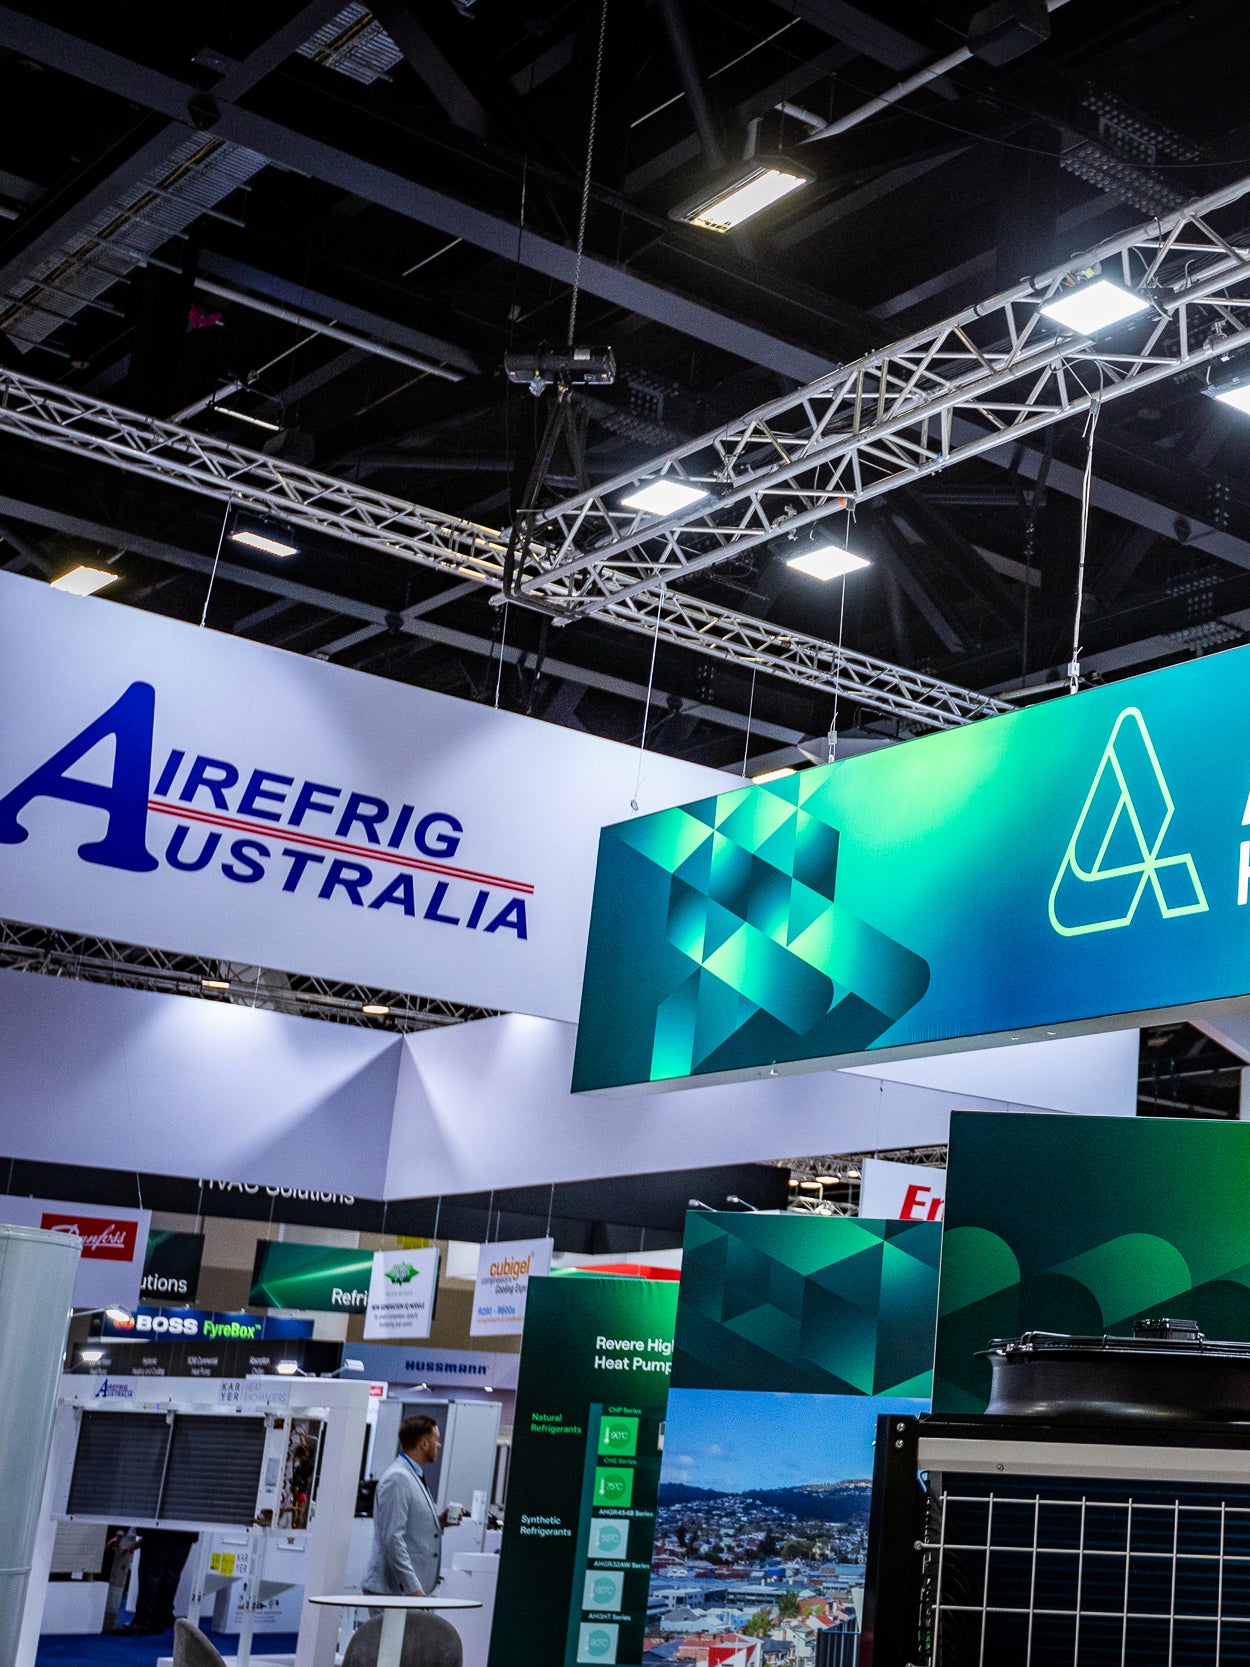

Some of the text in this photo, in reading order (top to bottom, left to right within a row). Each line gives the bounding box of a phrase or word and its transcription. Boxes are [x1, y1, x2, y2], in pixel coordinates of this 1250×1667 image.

[489, 1254, 531, 1281] cubigel
[135, 1314, 199, 1336] BOSS
[596, 1335, 645, 1352] Revere
[594, 1355, 630, 1371] Heat
[531, 1412, 563, 1423] Natural
[530, 1423, 582, 1435] Refrigerants
[521, 1514, 562, 1526] Synthetic
[520, 1526, 572, 1538] Refrigerants
